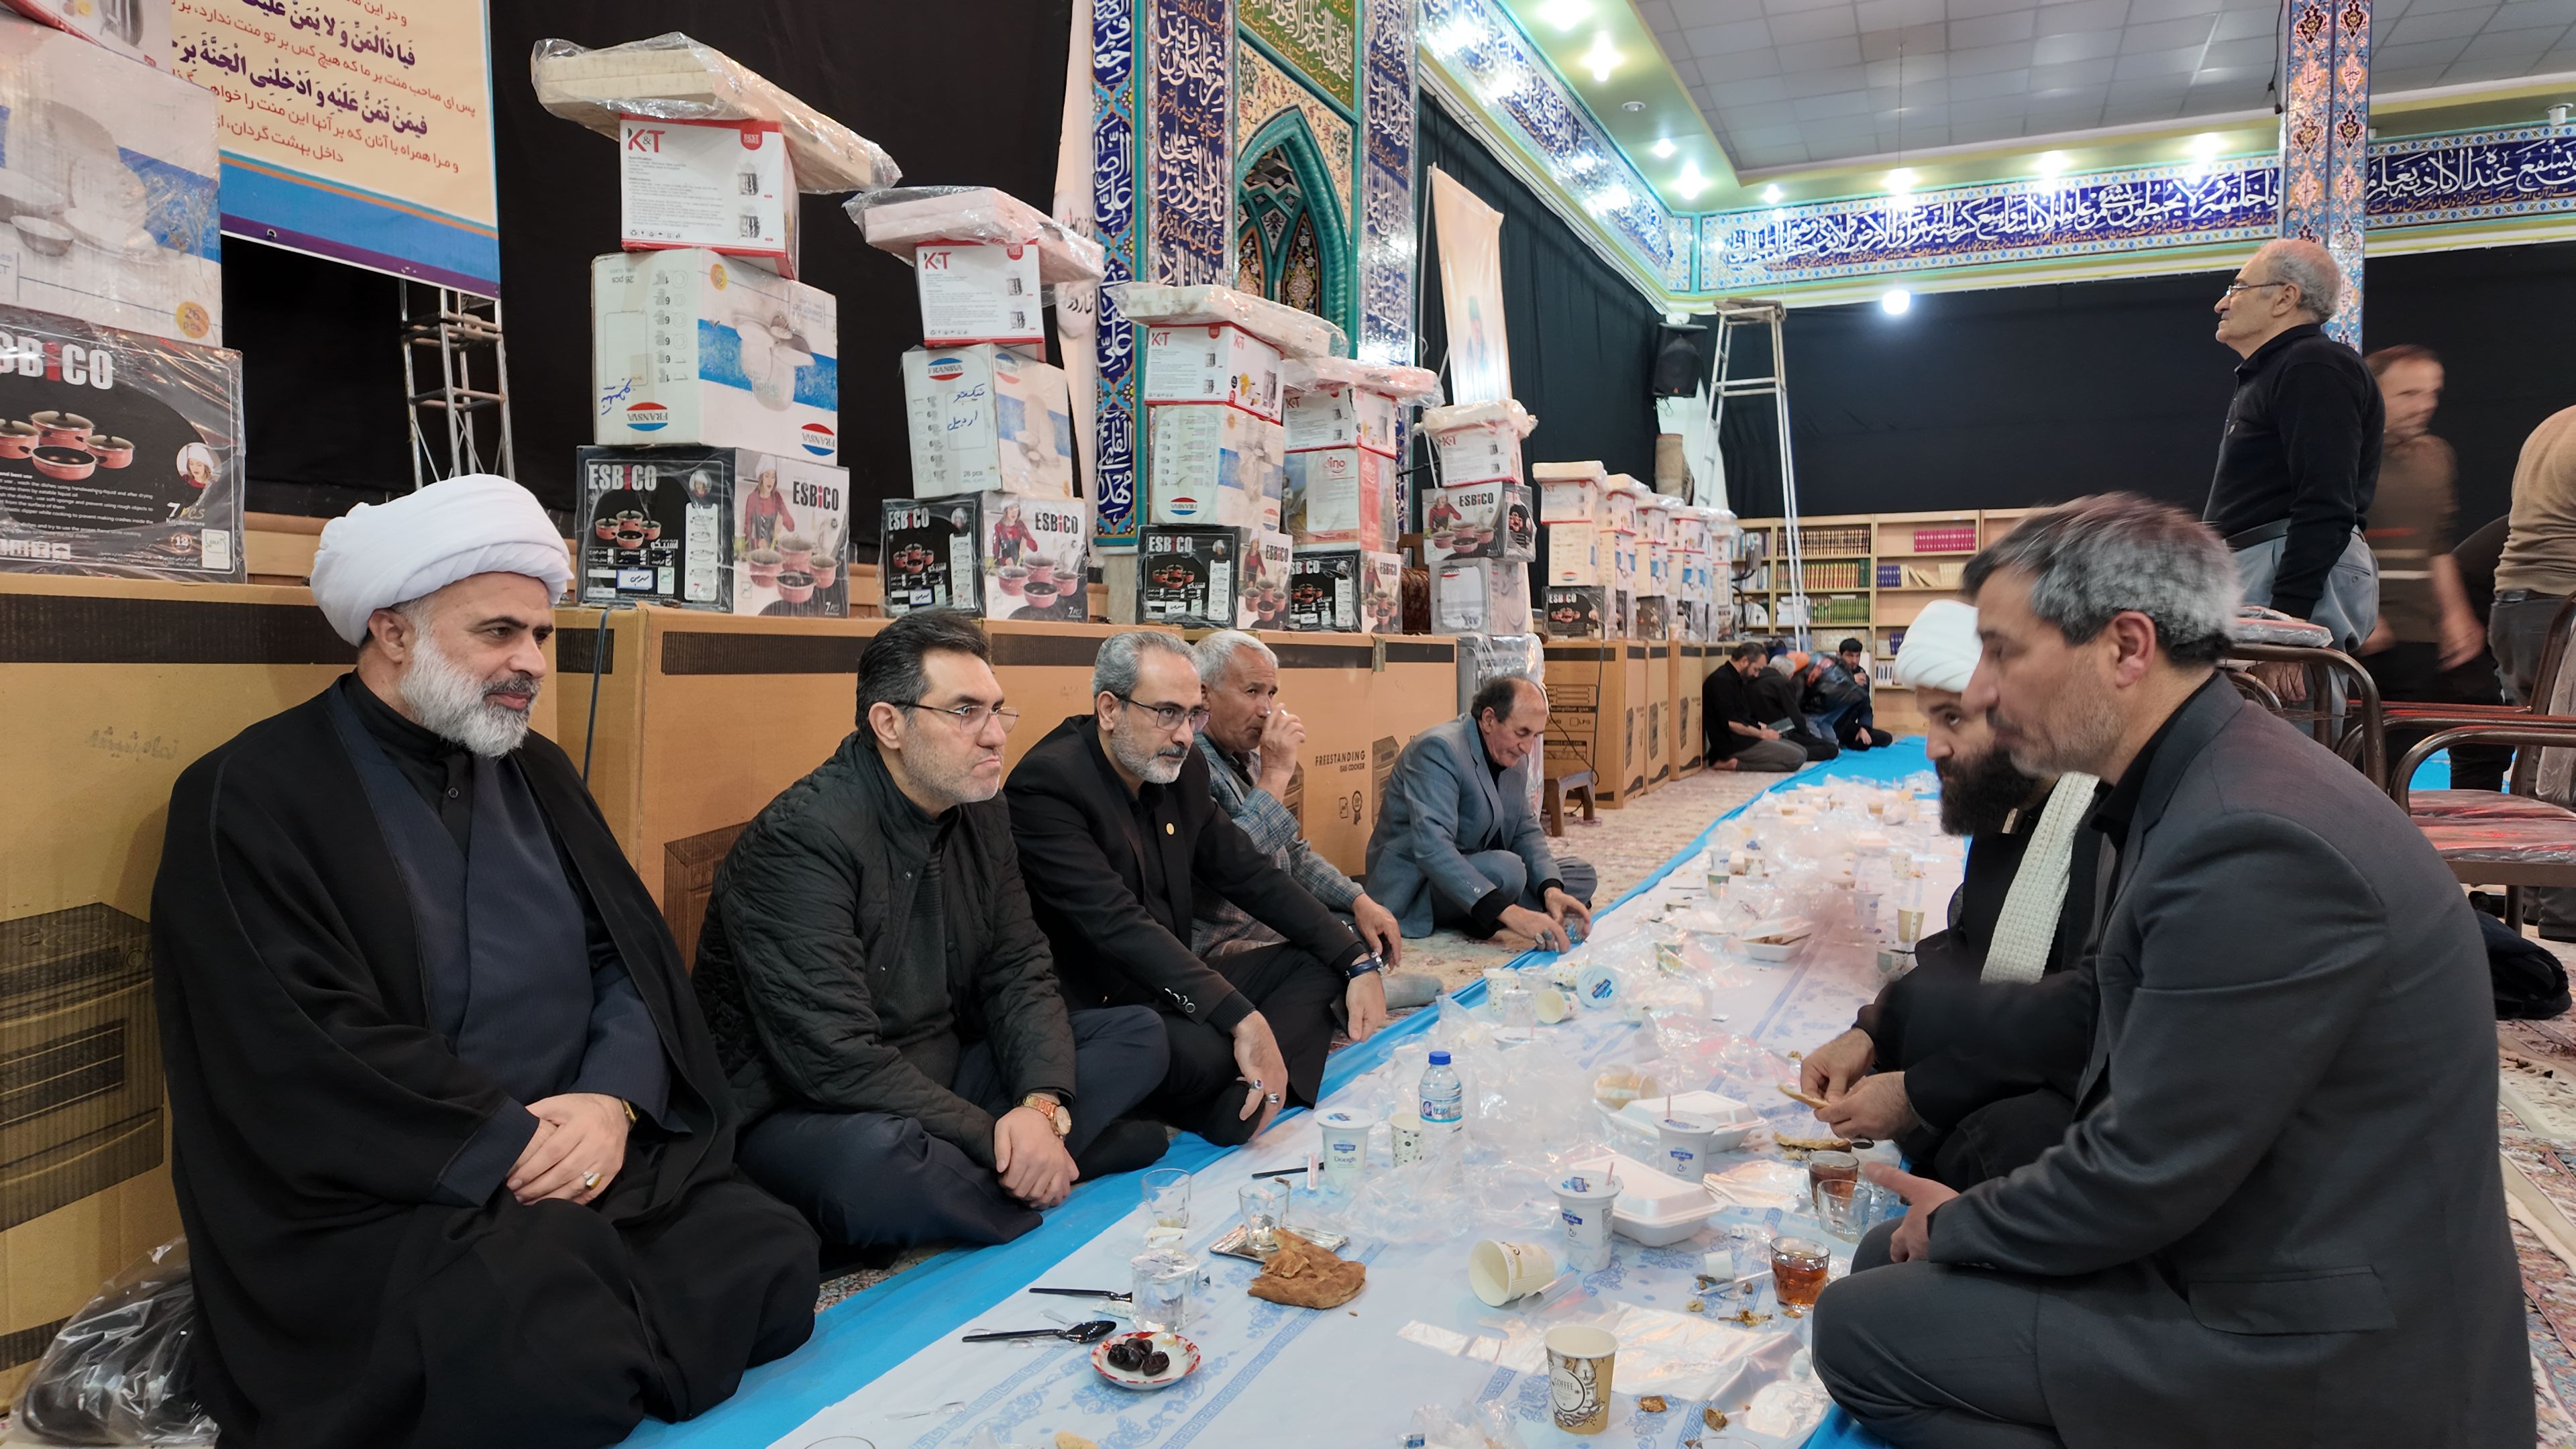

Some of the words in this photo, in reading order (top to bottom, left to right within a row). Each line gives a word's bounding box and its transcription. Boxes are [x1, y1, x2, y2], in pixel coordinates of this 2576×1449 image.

[364, 3, 382, 15] این
[385, 11, 397, 19] در
[234, 19, 261, 36] منت
[264, 32, 276, 43] تو
[278, 39, 289, 49] بر
[291, 45, 316, 56] کس
[318, 52, 340, 69] هیچ
[343, 61, 358, 72] که
[361, 65, 370, 76] ما
[372, 73, 382, 83] بر
[384, 74, 407, 90] منت
[245, 93, 254, 109] را
[409, 86, 441, 102] صاحب
[257, 99, 285, 115] منت
[443, 96, 455, 110] ای
[456, 103, 476, 117] پس
[288, 112, 309, 125] این
[312, 114, 332, 132] آنها
[333, 126, 344, 138] بر
[347, 129, 362, 140] که
[272, 133, 311, 156] بهشت
[365, 135, 388, 148] آنان
[390, 140, 398, 155] با
[628, 128, 665, 153] K&T
[313, 146, 343, 162] داخل
[400, 145, 430, 162] همراه
[434, 153, 450, 168] مرا
[184, 307, 200, 321] 26
[0, 331, 113, 390] SBiCO
[588, 464, 657, 491] ESBiCO
[793, 481, 839, 511] ESBiCO
[1459, 492, 1494, 507] ESBiCO
[167, 502, 180, 517] 7
[888, 507, 929, 531] ESBiCO
[1035, 511, 1078, 535] ESBiCO
[1291, 561, 1320, 575] SBiCO
[1316, 750, 1365, 766] FREESTANDING
